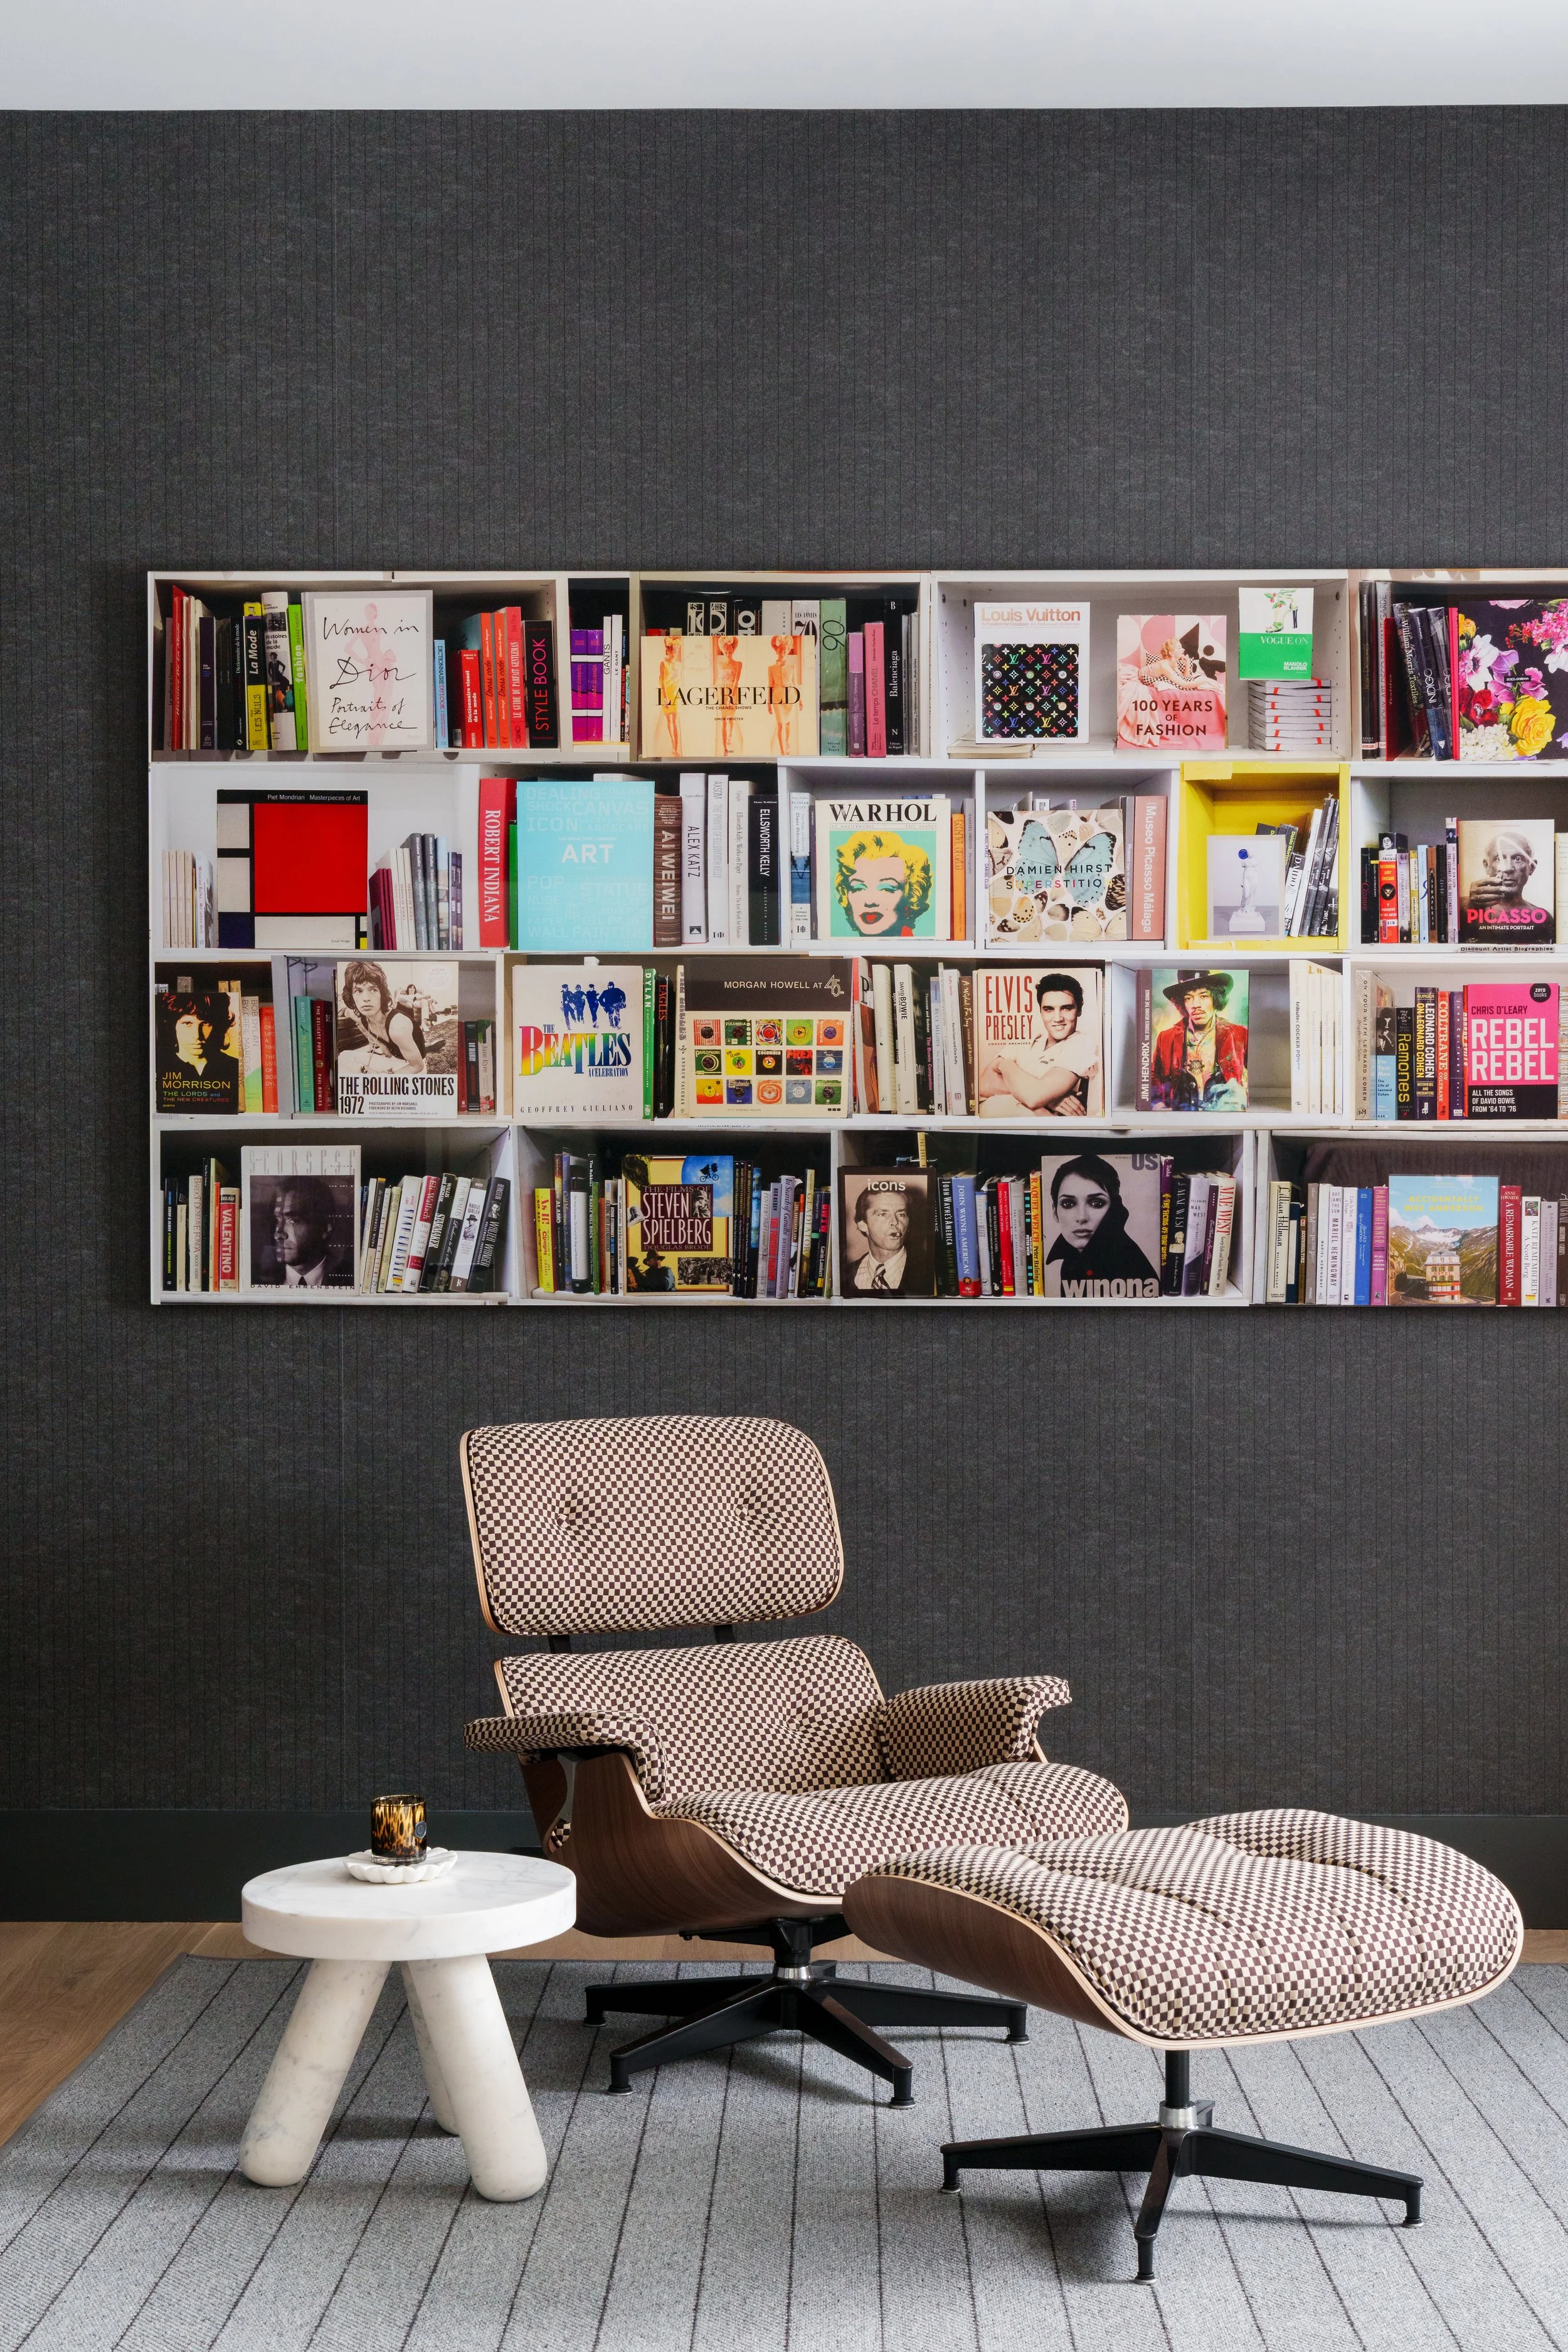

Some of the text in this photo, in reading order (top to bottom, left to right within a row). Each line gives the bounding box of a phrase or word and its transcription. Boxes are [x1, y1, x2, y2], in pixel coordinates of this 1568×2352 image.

[982, 608, 1080, 621] Louis Vuitton
[324, 617, 419, 640] Women in
[249, 630, 258, 674] La Mode
[1402, 619, 1417, 704] William Morris Textiles
[329, 656, 416, 689] Dior
[532, 638, 549, 730] STYLE BOOK
[889, 651, 900, 697] Balenciaga
[331, 696, 406, 714] Portraits of
[655, 686, 801, 706] LAGERFELD
[1132, 700, 1212, 711] 100 YEARS
[329, 718, 418, 739] Elegance
[1136, 725, 1206, 736] FASHION
[829, 804, 936, 821] WARHOL
[662, 830, 675, 848] AI
[760, 809, 770, 876] ELLSWORTH KELLY
[561, 844, 613, 863] ART
[688, 826, 700, 878] ALEX KATZ
[484, 810, 501, 923] ROBERT INDIANA
[1007, 864, 1112, 875] DAMIEN HIRST
[1143, 848, 1155, 890] Picasso
[662, 853, 675, 919] WEIWEI
[1007, 879, 1113, 890] SUPERSTITION
[1142, 893, 1154, 932] Málaga
[1467, 909, 1547, 923] PICASSO
[824, 975, 841, 997] 45
[986, 976, 1032, 1013] ELVIS
[1471, 1006, 1527, 1014] CHRIS O'LEARY
[543, 1024, 554, 1033] THE
[986, 1015, 1032, 1040] PRESLEY
[1471, 1018, 1554, 1049] REBEL
[519, 1026, 631, 1076] BEATLES
[1425, 1004, 1434, 1078] LEONARD COHEN
[588, 1068, 628, 1077] A CELEBRATION
[1142, 1042, 1150, 1081] HENDRIX
[1398, 1034, 1411, 1102] Ramones
[1472, 1050, 1554, 1080] REBEL
[339, 1077, 454, 1095] THE ROLLING STONES
[339, 1097, 364, 1114] 1972
[1131, 1154, 1158, 1171] US
[868, 1179, 905, 1191] icons
[423, 1194, 435, 1219] Wallach
[643, 1193, 689, 1218] STEVEN
[943, 1196, 951, 1222] WAYNE'S
[1217, 1186, 1234, 1235] MAE WEST
[1278, 1185, 1290, 1247] Lillian Hellman
[222, 1209, 231, 1274] VALENTINO
[644, 1220, 711, 1244] SPIELBERG
[945, 1222, 953, 1245] AMERICA
[961, 1237, 970, 1274] AMERICAN
[1506, 1259, 1514, 1289] WOMAN
[1062, 1279, 1158, 1297] winona
